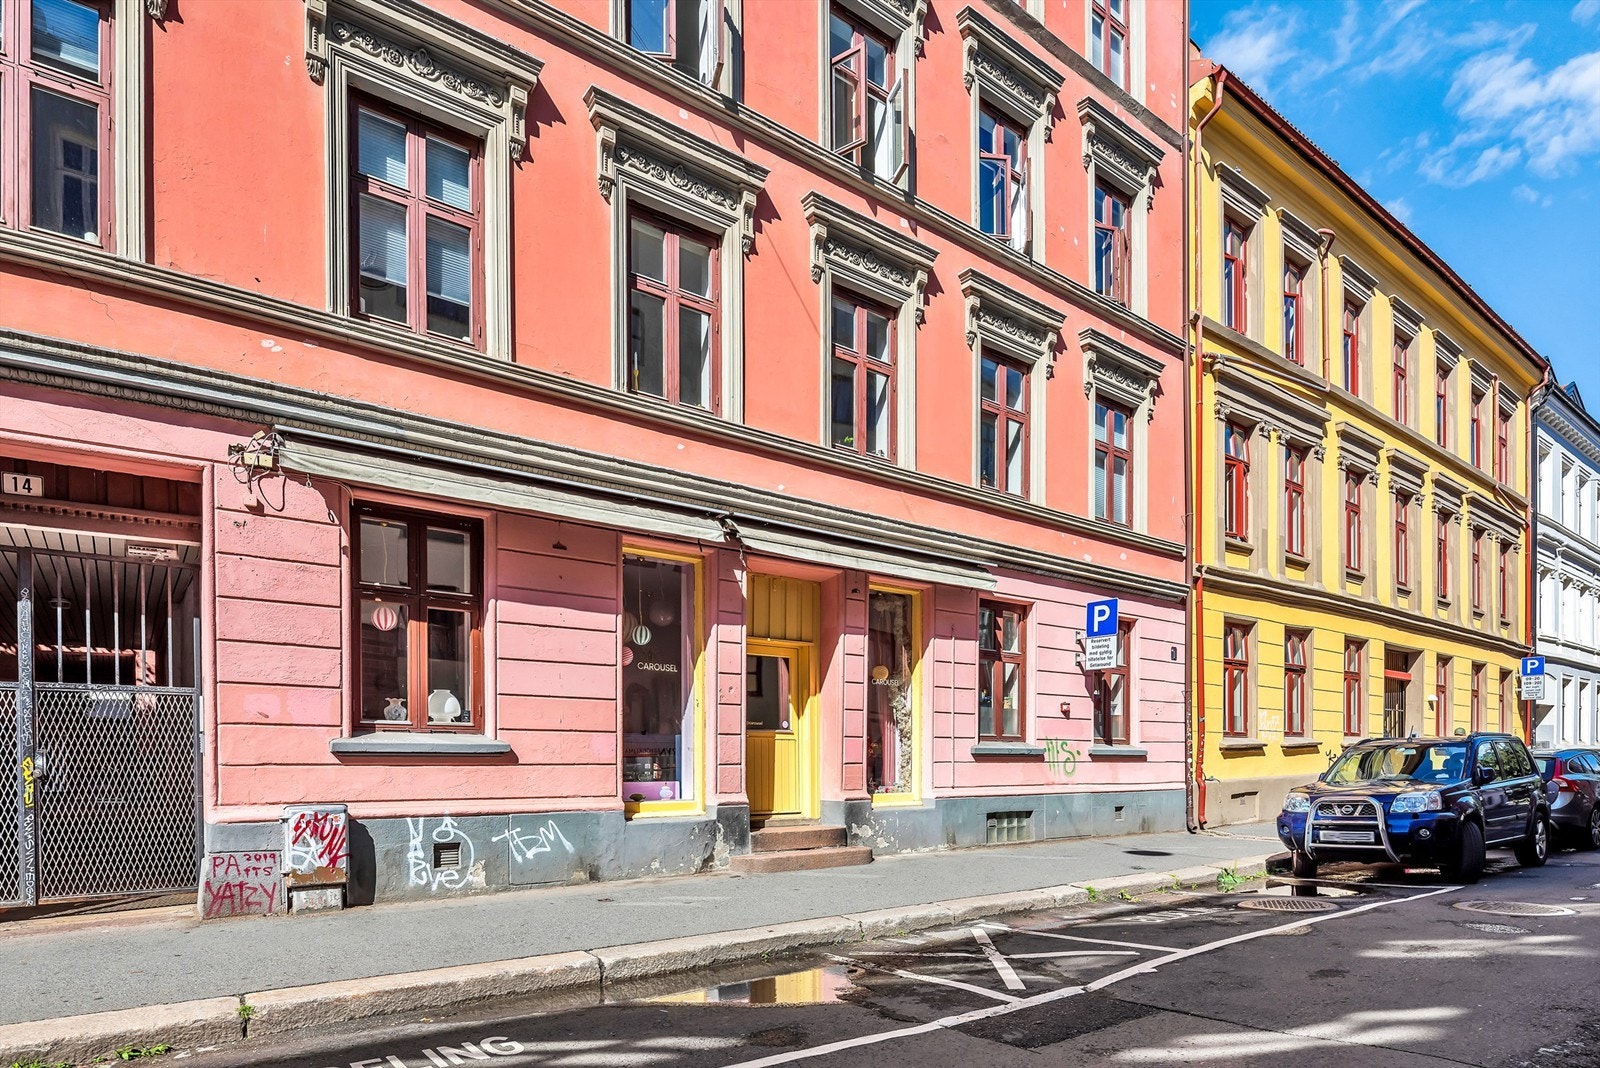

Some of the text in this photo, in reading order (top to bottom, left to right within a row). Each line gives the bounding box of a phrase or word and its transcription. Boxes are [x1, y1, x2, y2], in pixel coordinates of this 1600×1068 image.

[12, 477, 32, 493] 14
[1093, 604, 1110, 632] P
[637, 662, 678, 672] CAROUSEL
[1527, 659, 1539, 673] P
[871, 678, 899, 687] CAROUSEL
[212, 854, 242, 878] PA
[204, 880, 277, 918] YATZY
